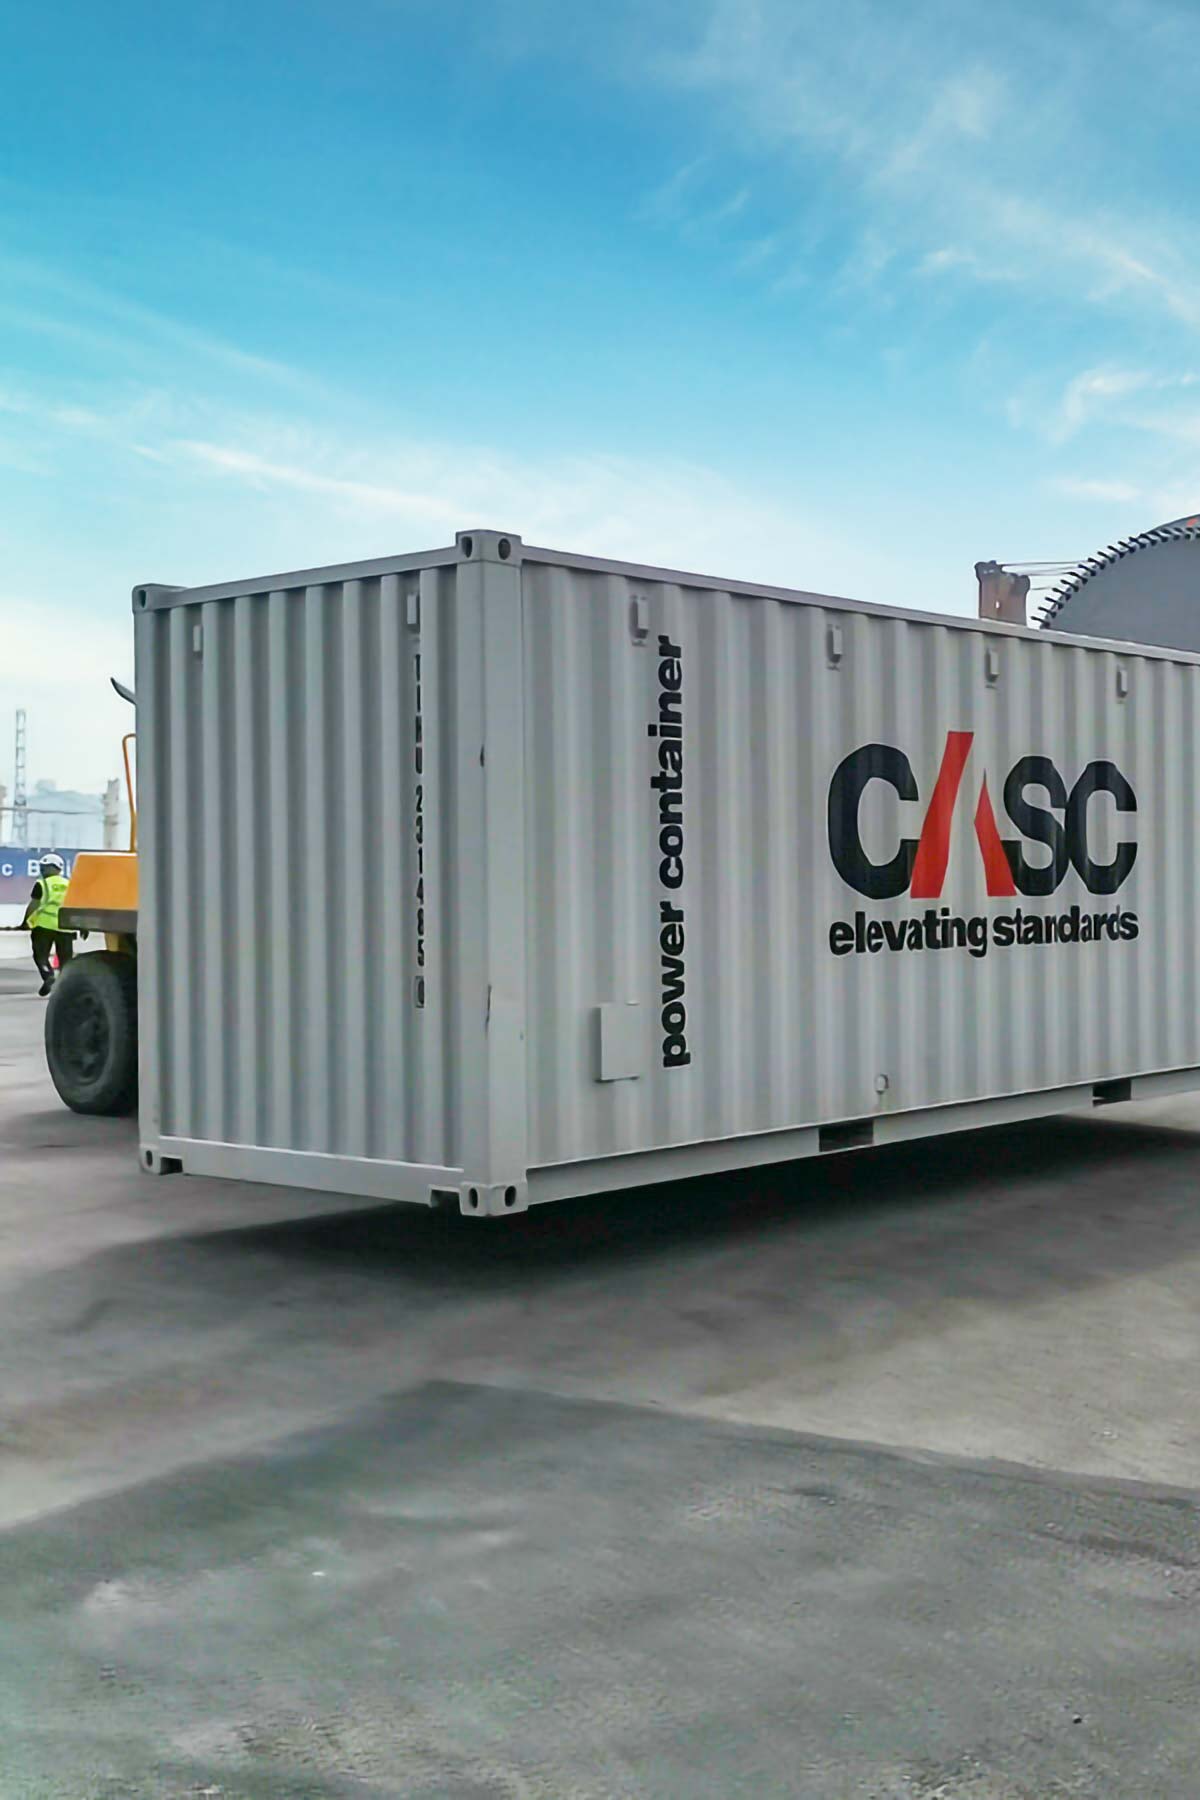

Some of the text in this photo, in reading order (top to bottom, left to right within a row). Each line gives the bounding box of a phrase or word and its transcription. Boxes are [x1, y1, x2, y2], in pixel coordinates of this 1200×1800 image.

[648, 635, 692, 1068] power container
[827, 731, 1138, 900] CASC
[828, 905, 1139, 958] elevating standards
